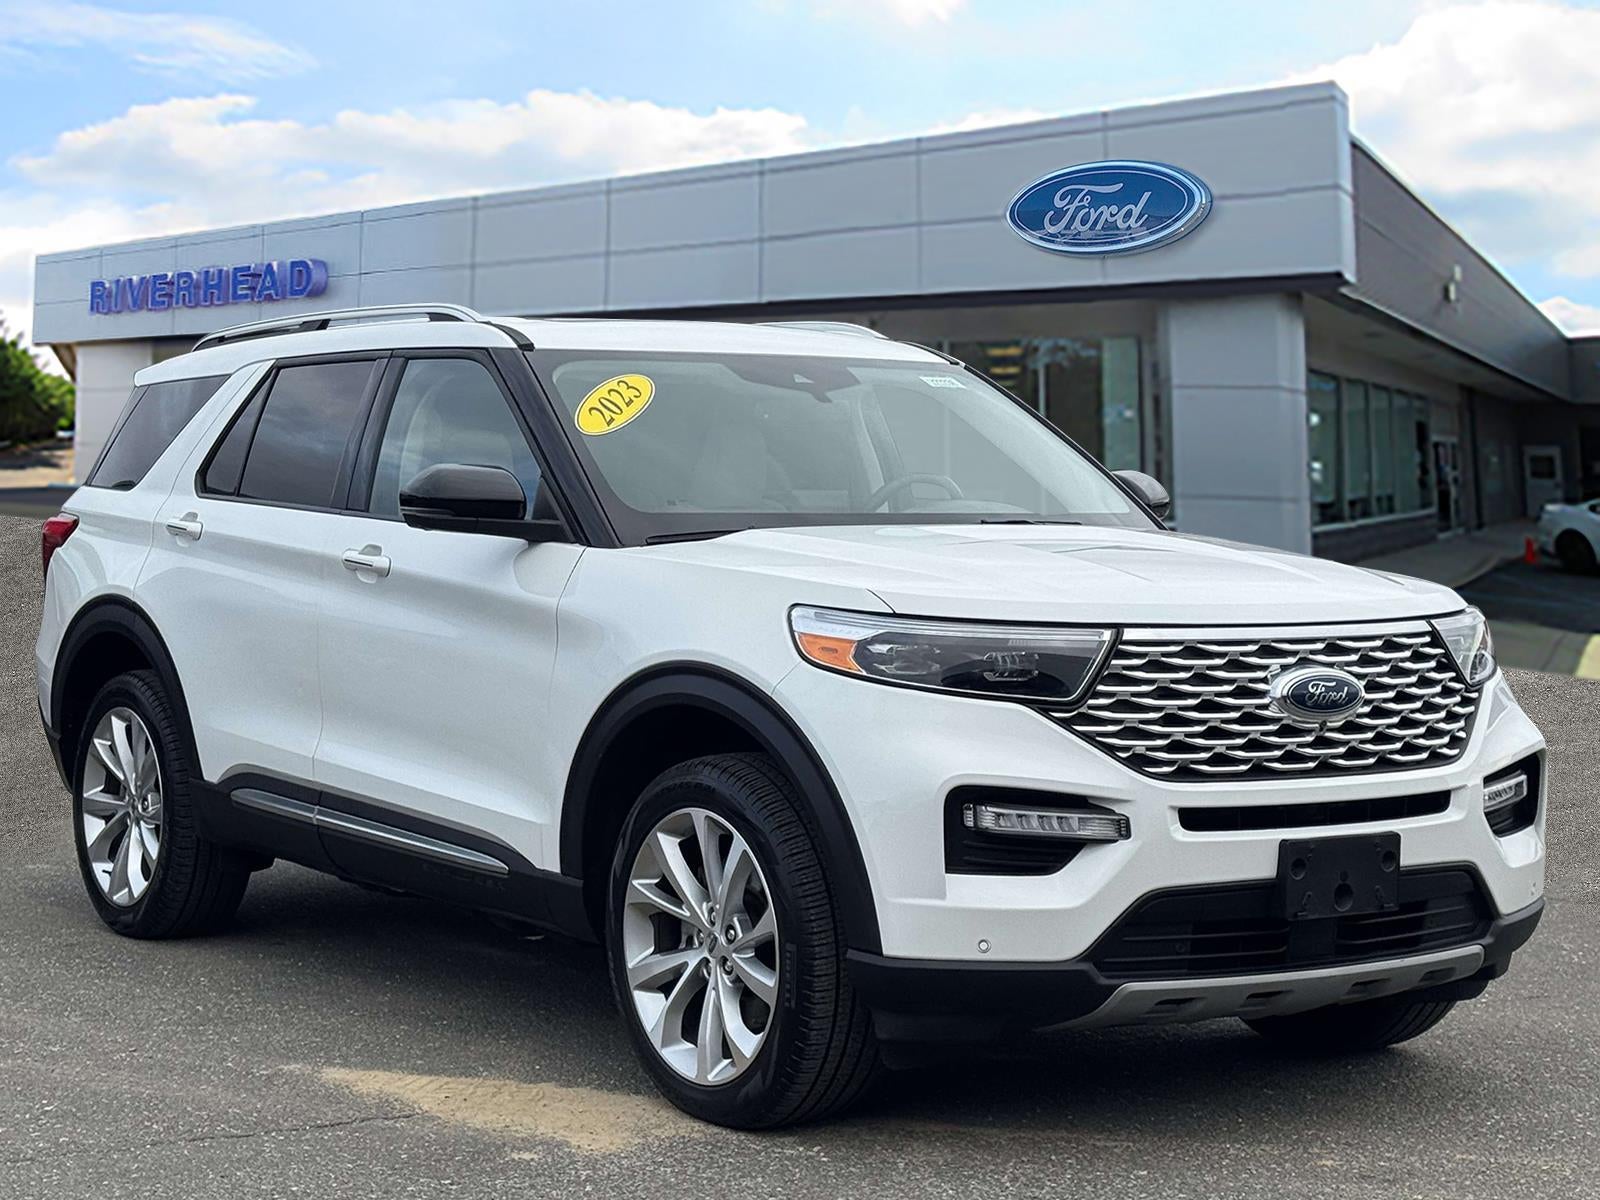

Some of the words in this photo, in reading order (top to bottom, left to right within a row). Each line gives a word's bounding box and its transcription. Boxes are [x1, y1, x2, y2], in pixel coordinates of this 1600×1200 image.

[1043, 182, 1152, 234] Ford
[89, 258, 326, 315] RIVERHEAD
[588, 380, 642, 427] 2023
[1304, 680, 1349, 706] Ford
